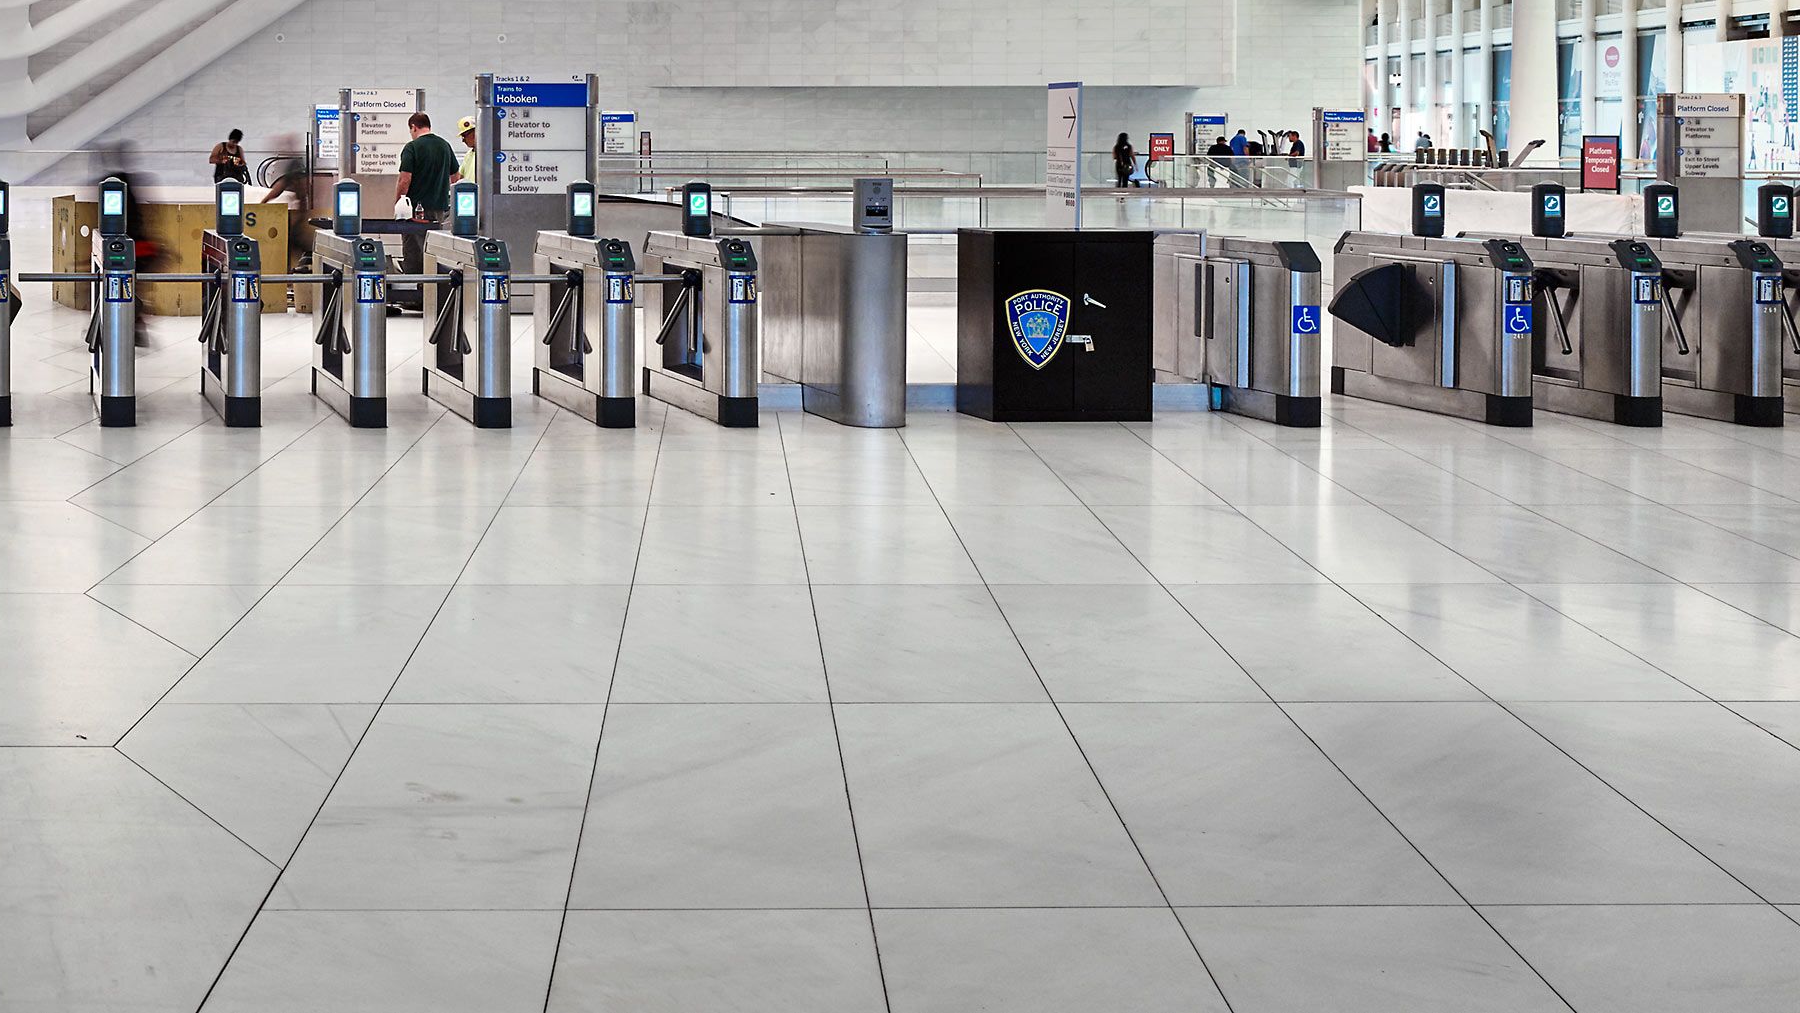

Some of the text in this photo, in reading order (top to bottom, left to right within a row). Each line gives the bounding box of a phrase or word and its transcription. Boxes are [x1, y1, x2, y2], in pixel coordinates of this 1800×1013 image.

[496, 95, 538, 103] Hoboken
[1585, 157, 1616, 165] Temporarily
[508, 175, 532, 183] Upper
[508, 185, 539, 193] Subway
[1013, 294, 1064, 305] PORT AUTHORITY
[1015, 300, 1063, 315] POLICE
[1012, 321, 1033, 356] NEW YORK
[1041, 319, 1064, 359] NEW JERSEY
